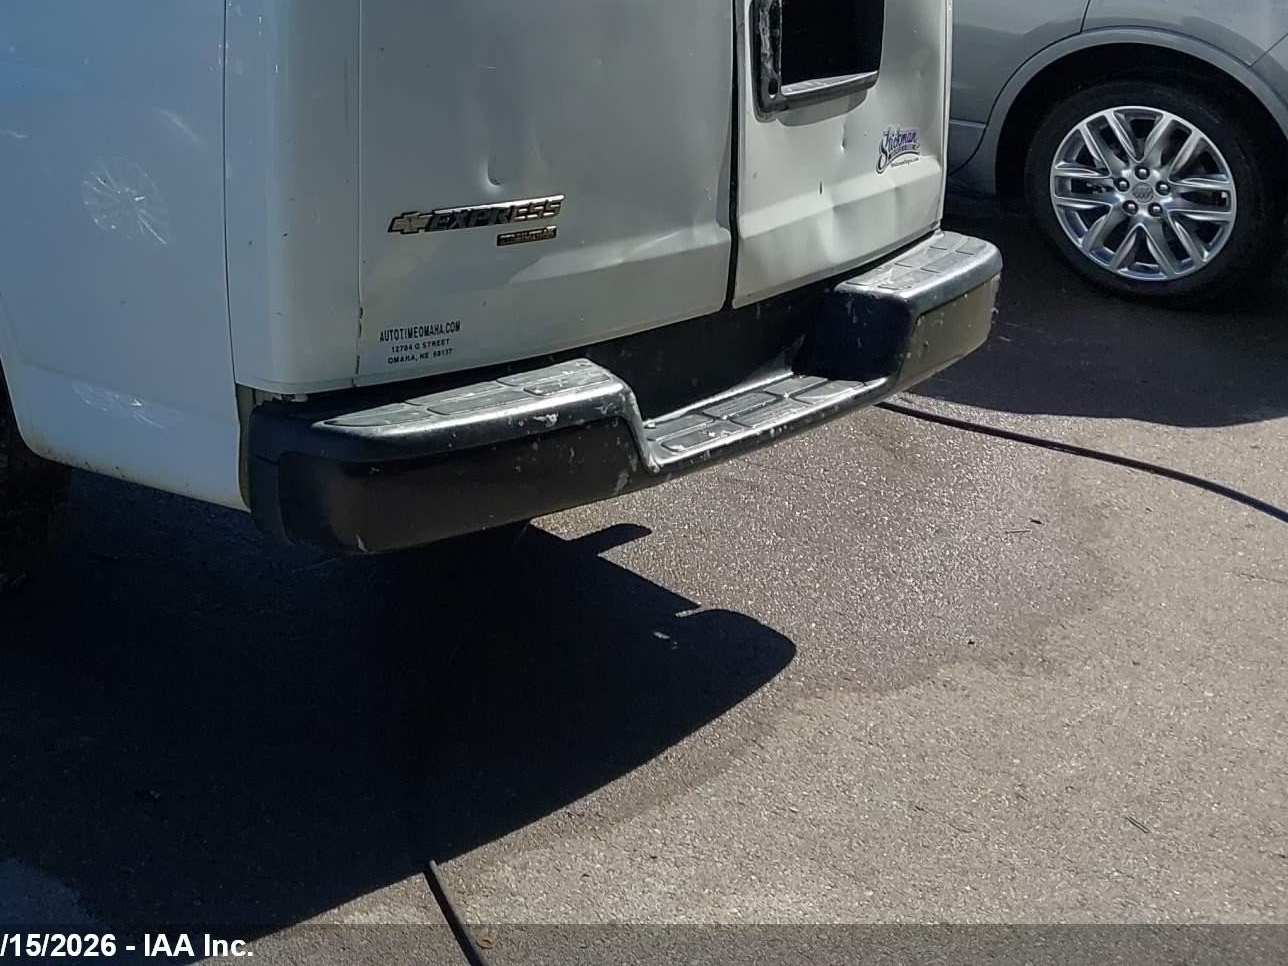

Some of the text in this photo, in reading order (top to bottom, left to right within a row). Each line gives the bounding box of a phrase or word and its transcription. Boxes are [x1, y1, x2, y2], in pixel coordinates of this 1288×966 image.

[430, 200, 562, 232] EXPRESS
[380, 321, 461, 342] AUTOTIMEOMAHA.COM
[422, 339, 450, 349] STREET
[388, 354, 418, 364] OMAHA,
